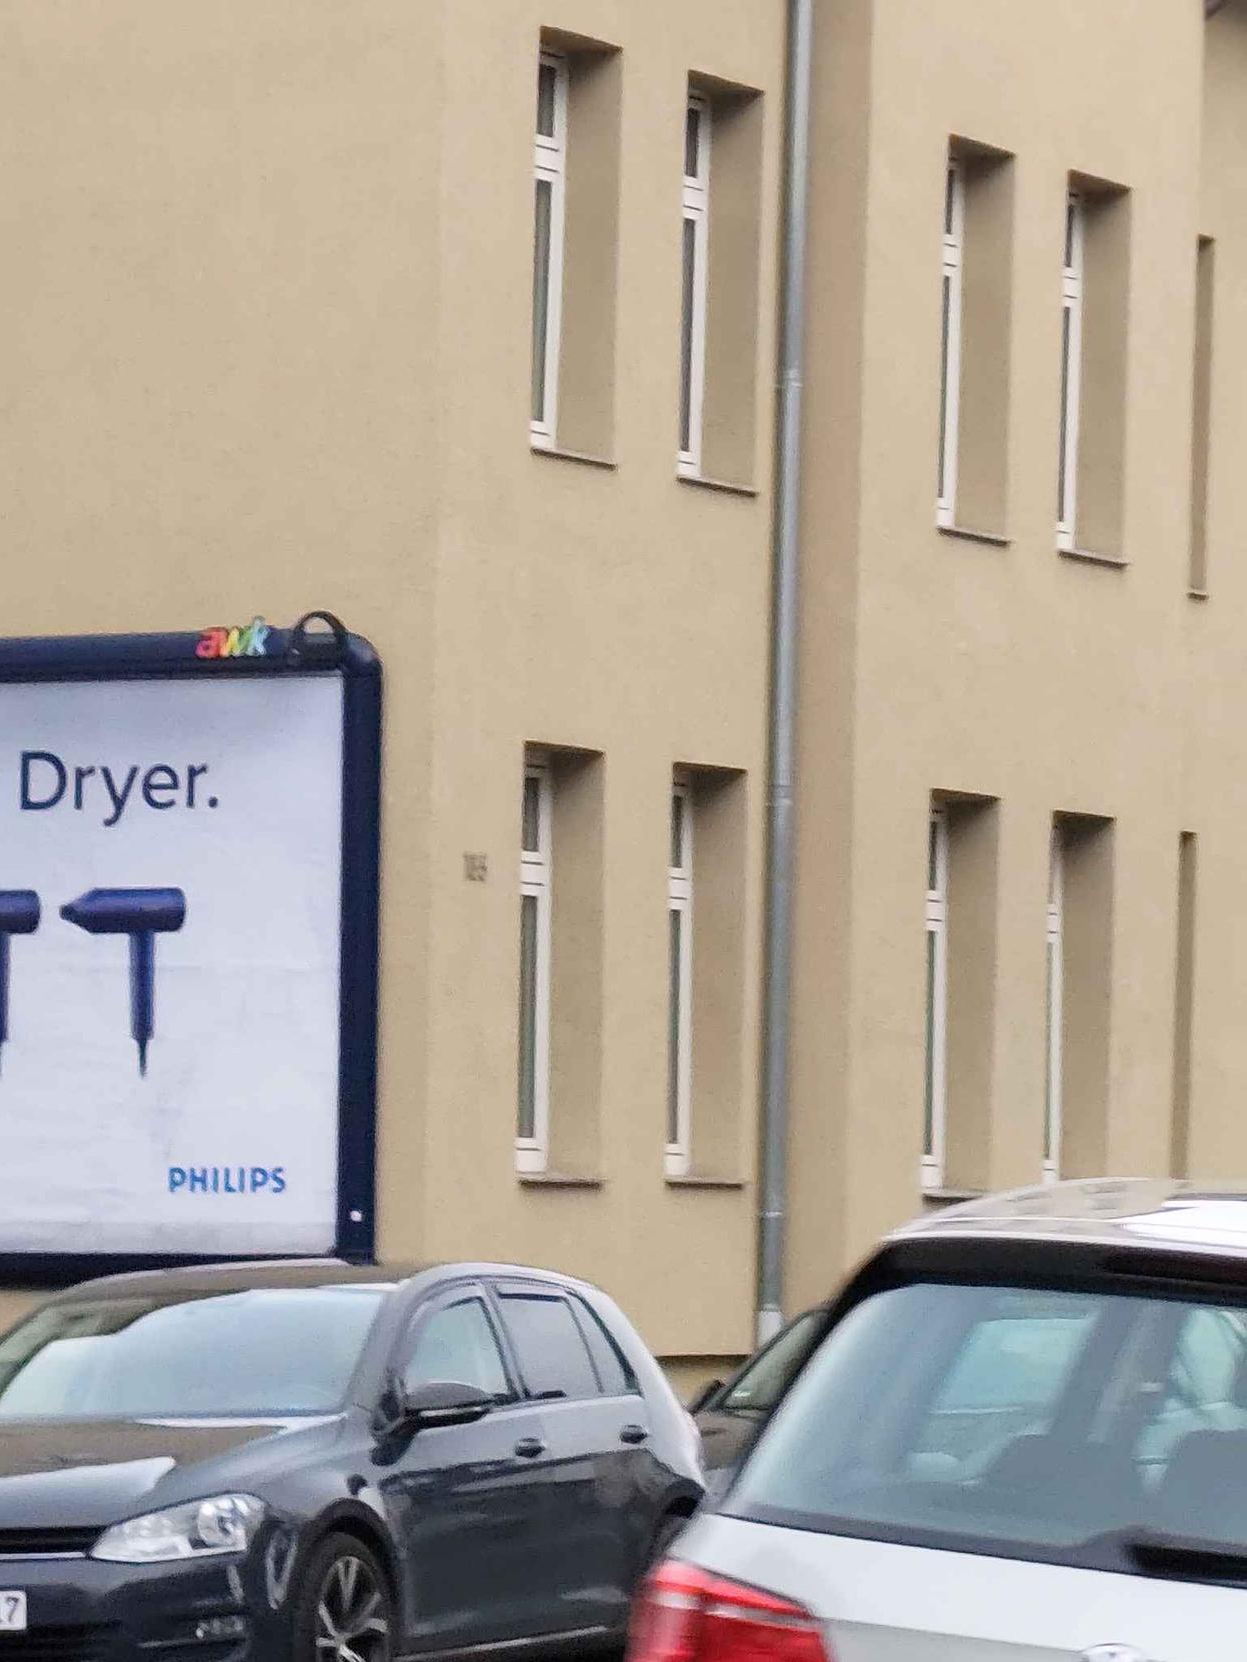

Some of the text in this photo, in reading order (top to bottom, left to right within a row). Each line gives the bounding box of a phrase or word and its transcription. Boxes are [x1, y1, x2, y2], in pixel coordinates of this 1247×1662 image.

[195, 615, 268, 658] awk
[19, 750, 219, 827] Dryer.
[168, 1167, 286, 1193] PHILIPS
